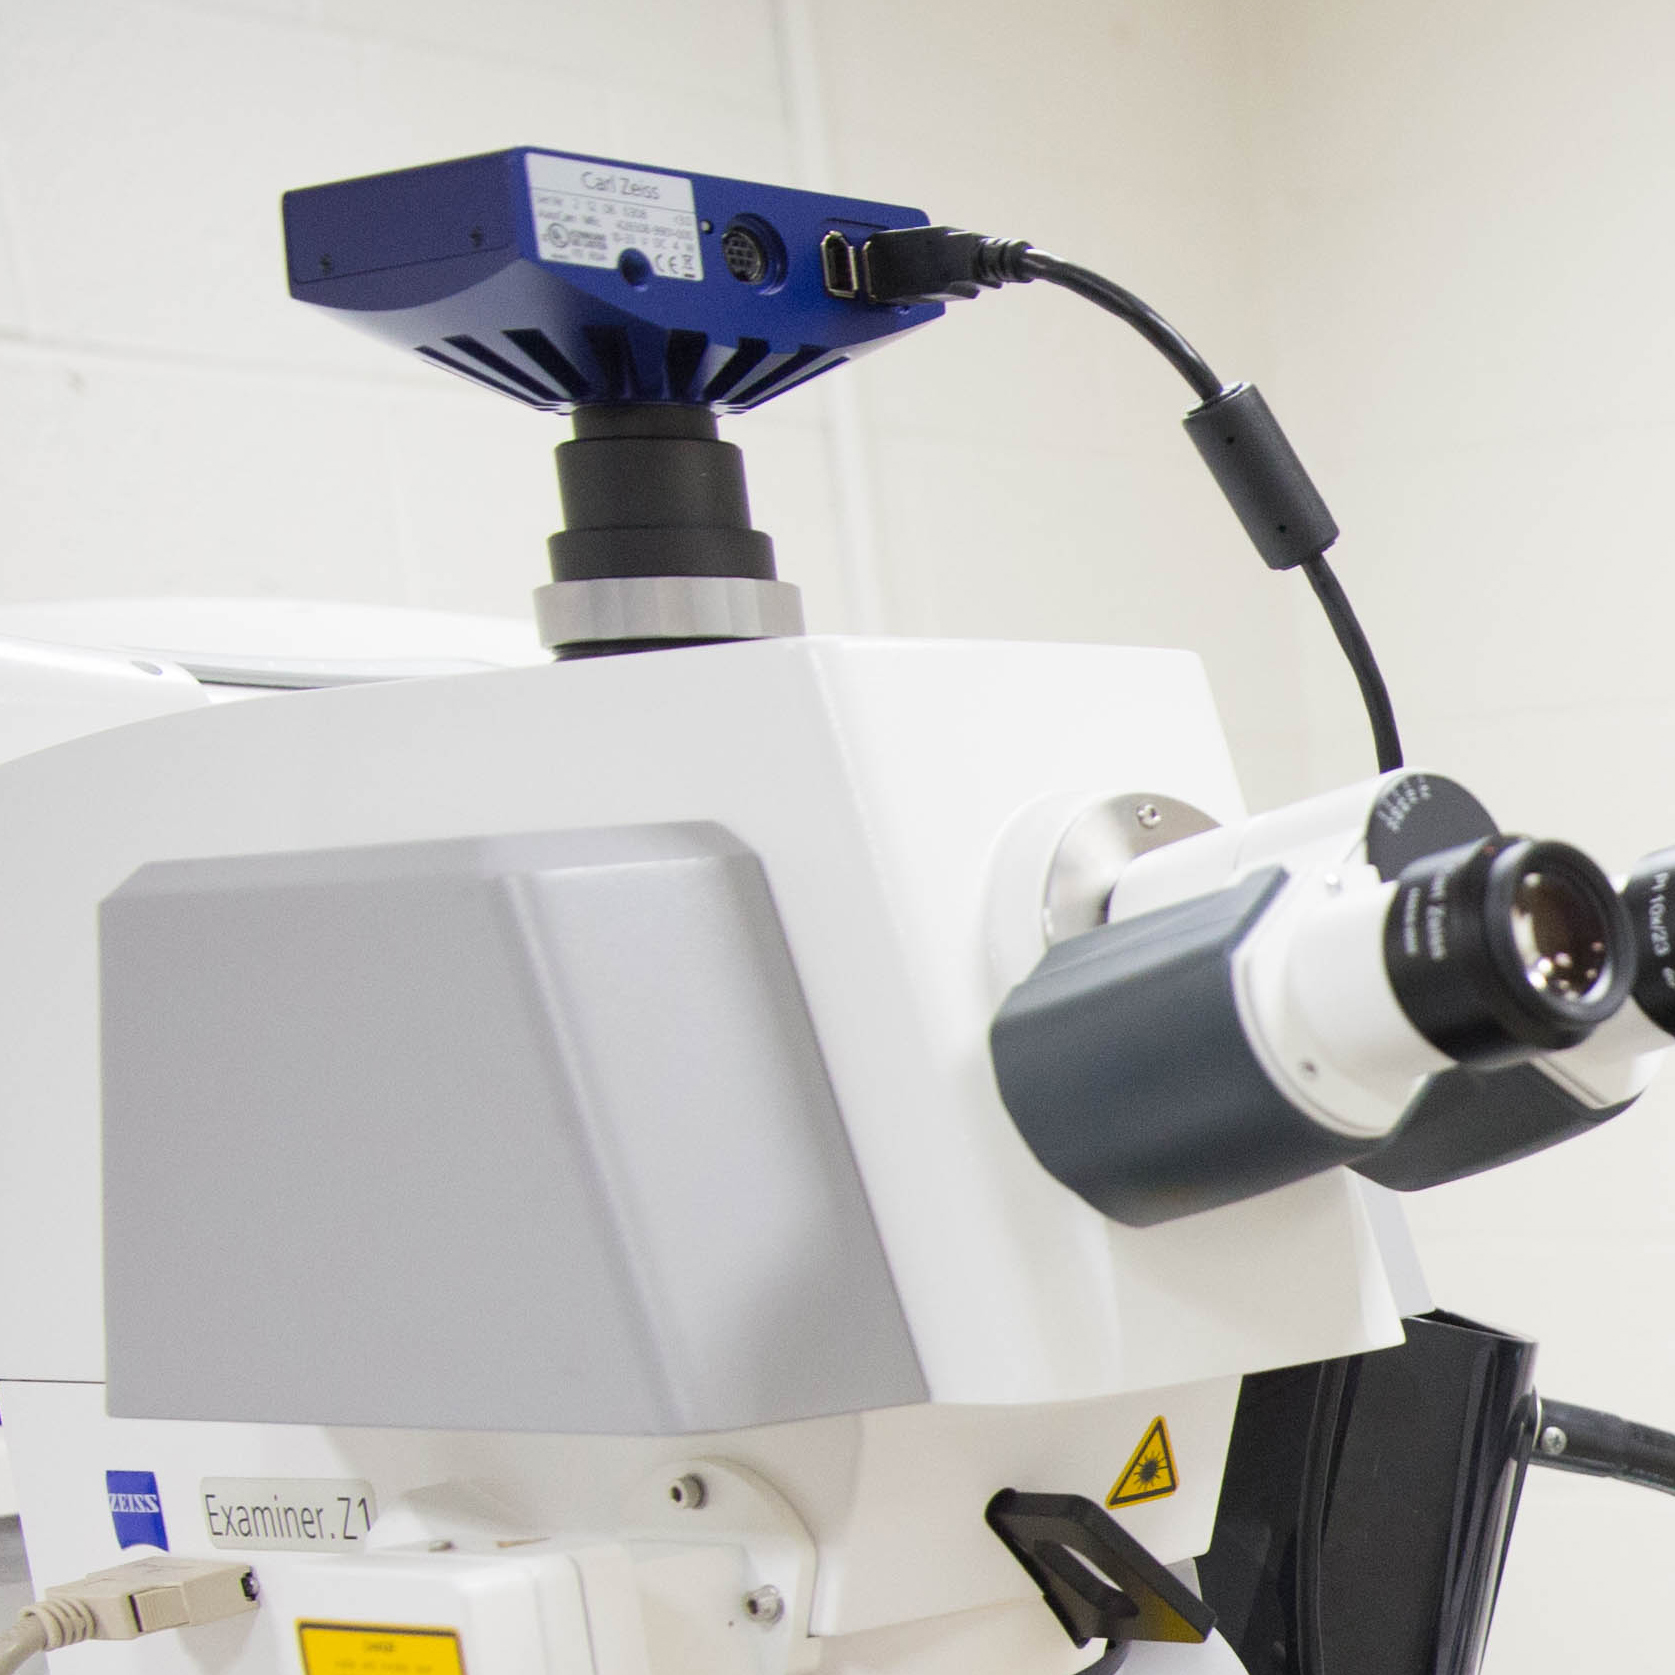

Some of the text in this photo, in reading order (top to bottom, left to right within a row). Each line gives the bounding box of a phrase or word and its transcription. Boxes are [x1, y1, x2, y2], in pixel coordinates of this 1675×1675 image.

[581, 171, 661, 201] Carl Zeiss
[107, 1493, 160, 1513] ZEISS
